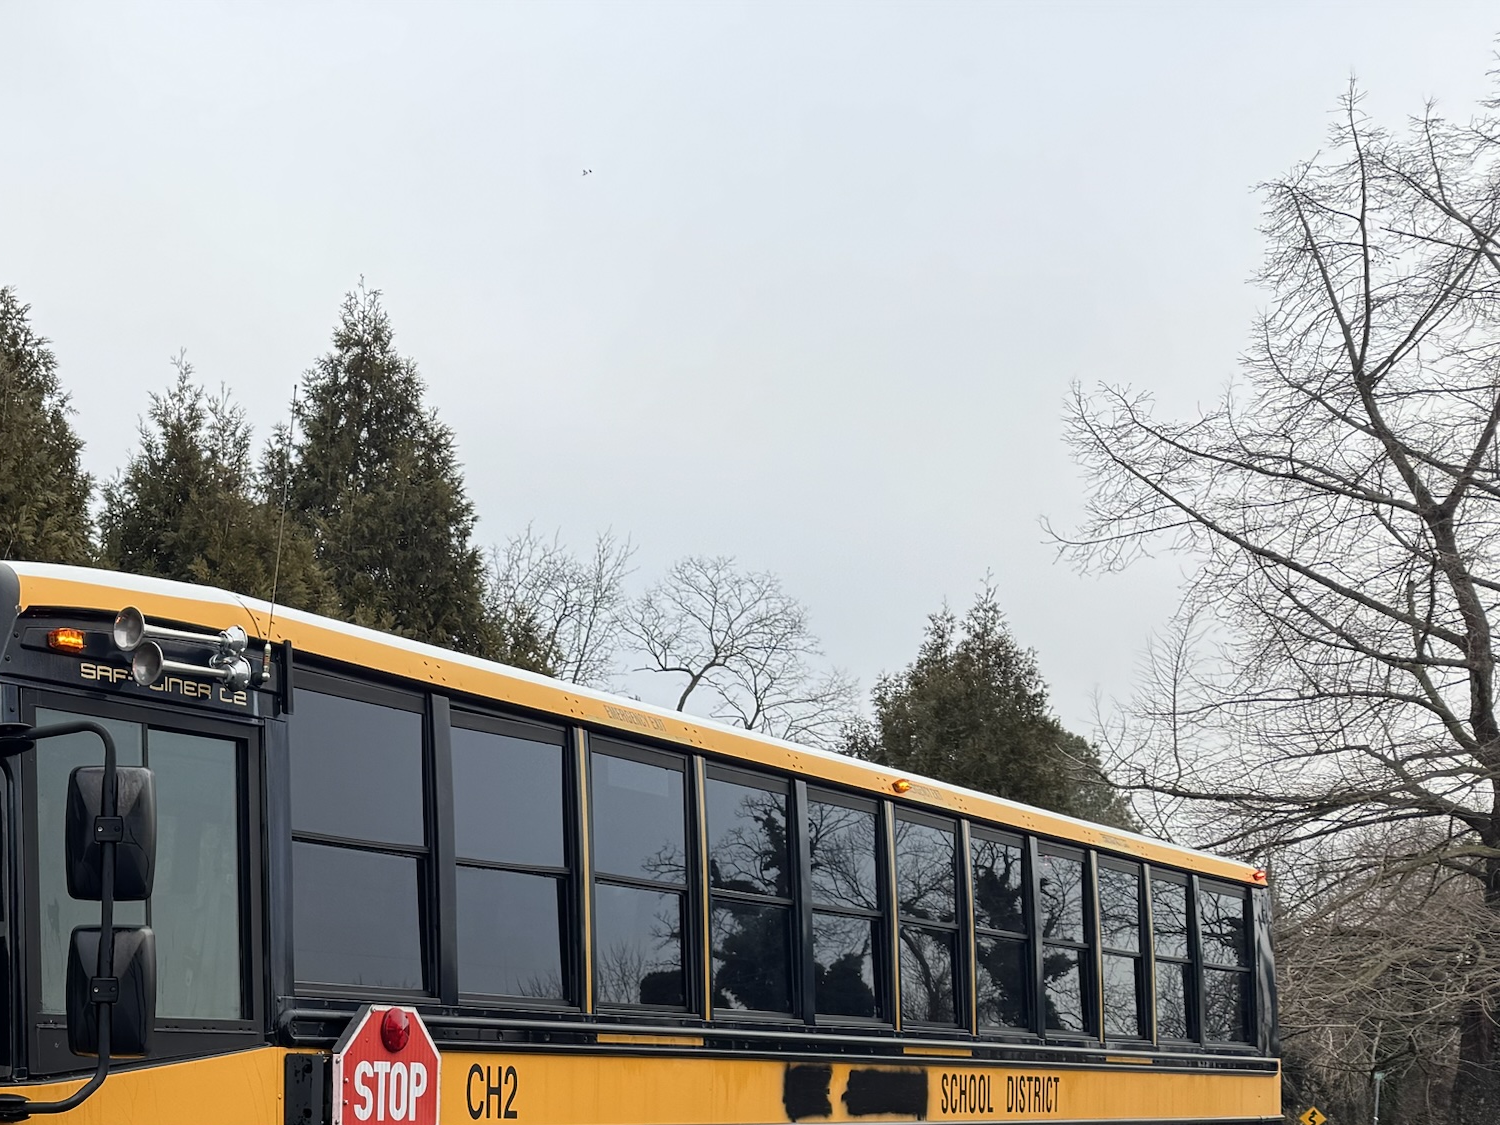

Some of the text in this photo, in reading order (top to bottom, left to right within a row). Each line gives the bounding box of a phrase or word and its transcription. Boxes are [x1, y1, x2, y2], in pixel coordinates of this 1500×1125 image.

[219, 687, 247, 706] C2
[353, 1060, 428, 1122] STOP
[466, 1063, 518, 1120] CH2
[940, 1072, 1060, 1115] SCHOOL DISTRICT
